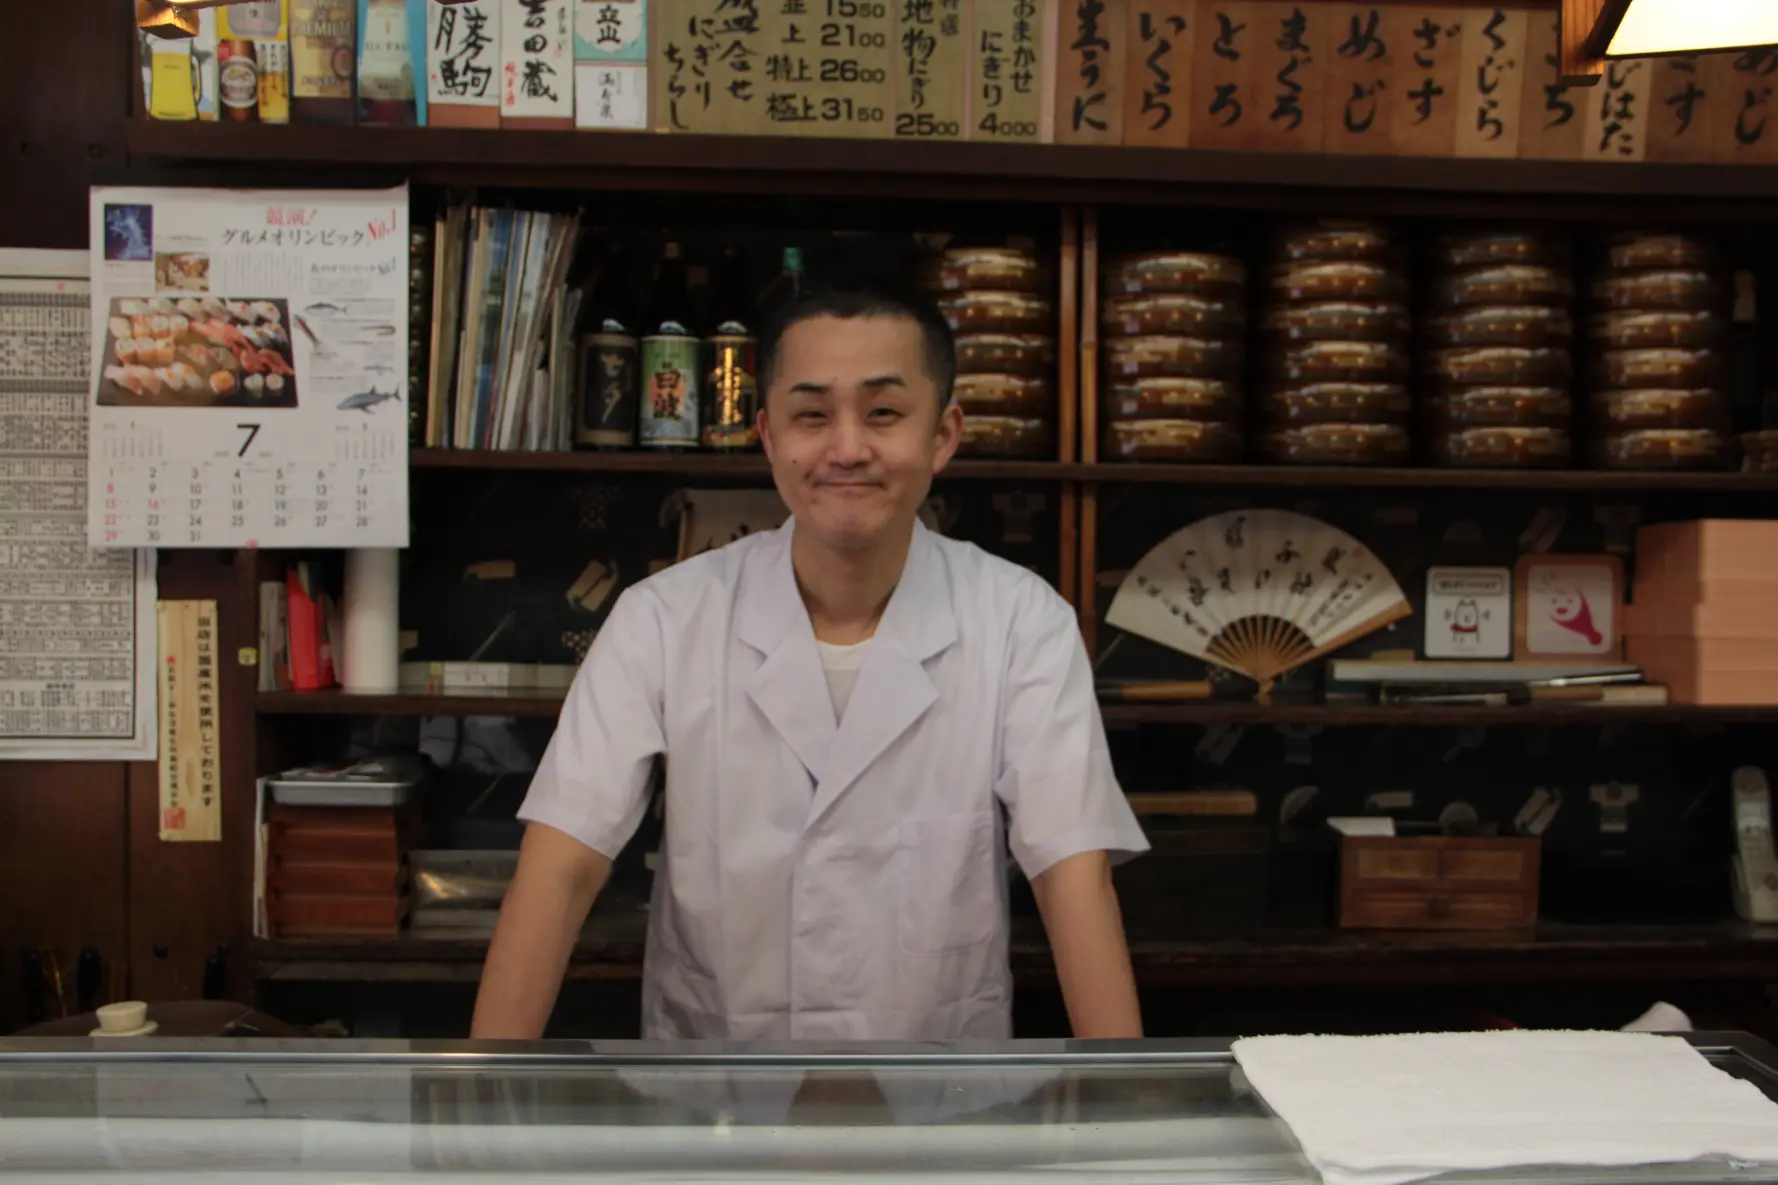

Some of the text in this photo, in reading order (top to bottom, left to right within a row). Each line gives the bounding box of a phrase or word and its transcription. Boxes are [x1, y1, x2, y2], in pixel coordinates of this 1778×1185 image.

[597, 4, 622, 44] 立山
[781, 23, 885, 48] 上 2100
[825, 0, 885, 18] 1550
[1009, 0, 1037, 94] おまかせ
[433, 7, 490, 97] 勝駒
[663, 43, 689, 130] ちらし
[688, 16, 720, 110] にぎり
[766, 54, 885, 83] 特上 2600
[980, 30, 1009, 108] にぎり
[1139, 12, 1187, 130] いくら
[1207, 12, 1246, 127] とろ
[1268, 8, 1312, 132] まぐろ
[1476, 10, 1515, 141] くじら
[766, 93, 884, 122] 極上 3150
[895, 113, 959, 136] 2500
[979, 112, 1037, 136] 4000
[1600, 59, 1643, 155] じはた
[222, 228, 365, 247] グルメオリンピック
[237, 423, 261, 457] 7
